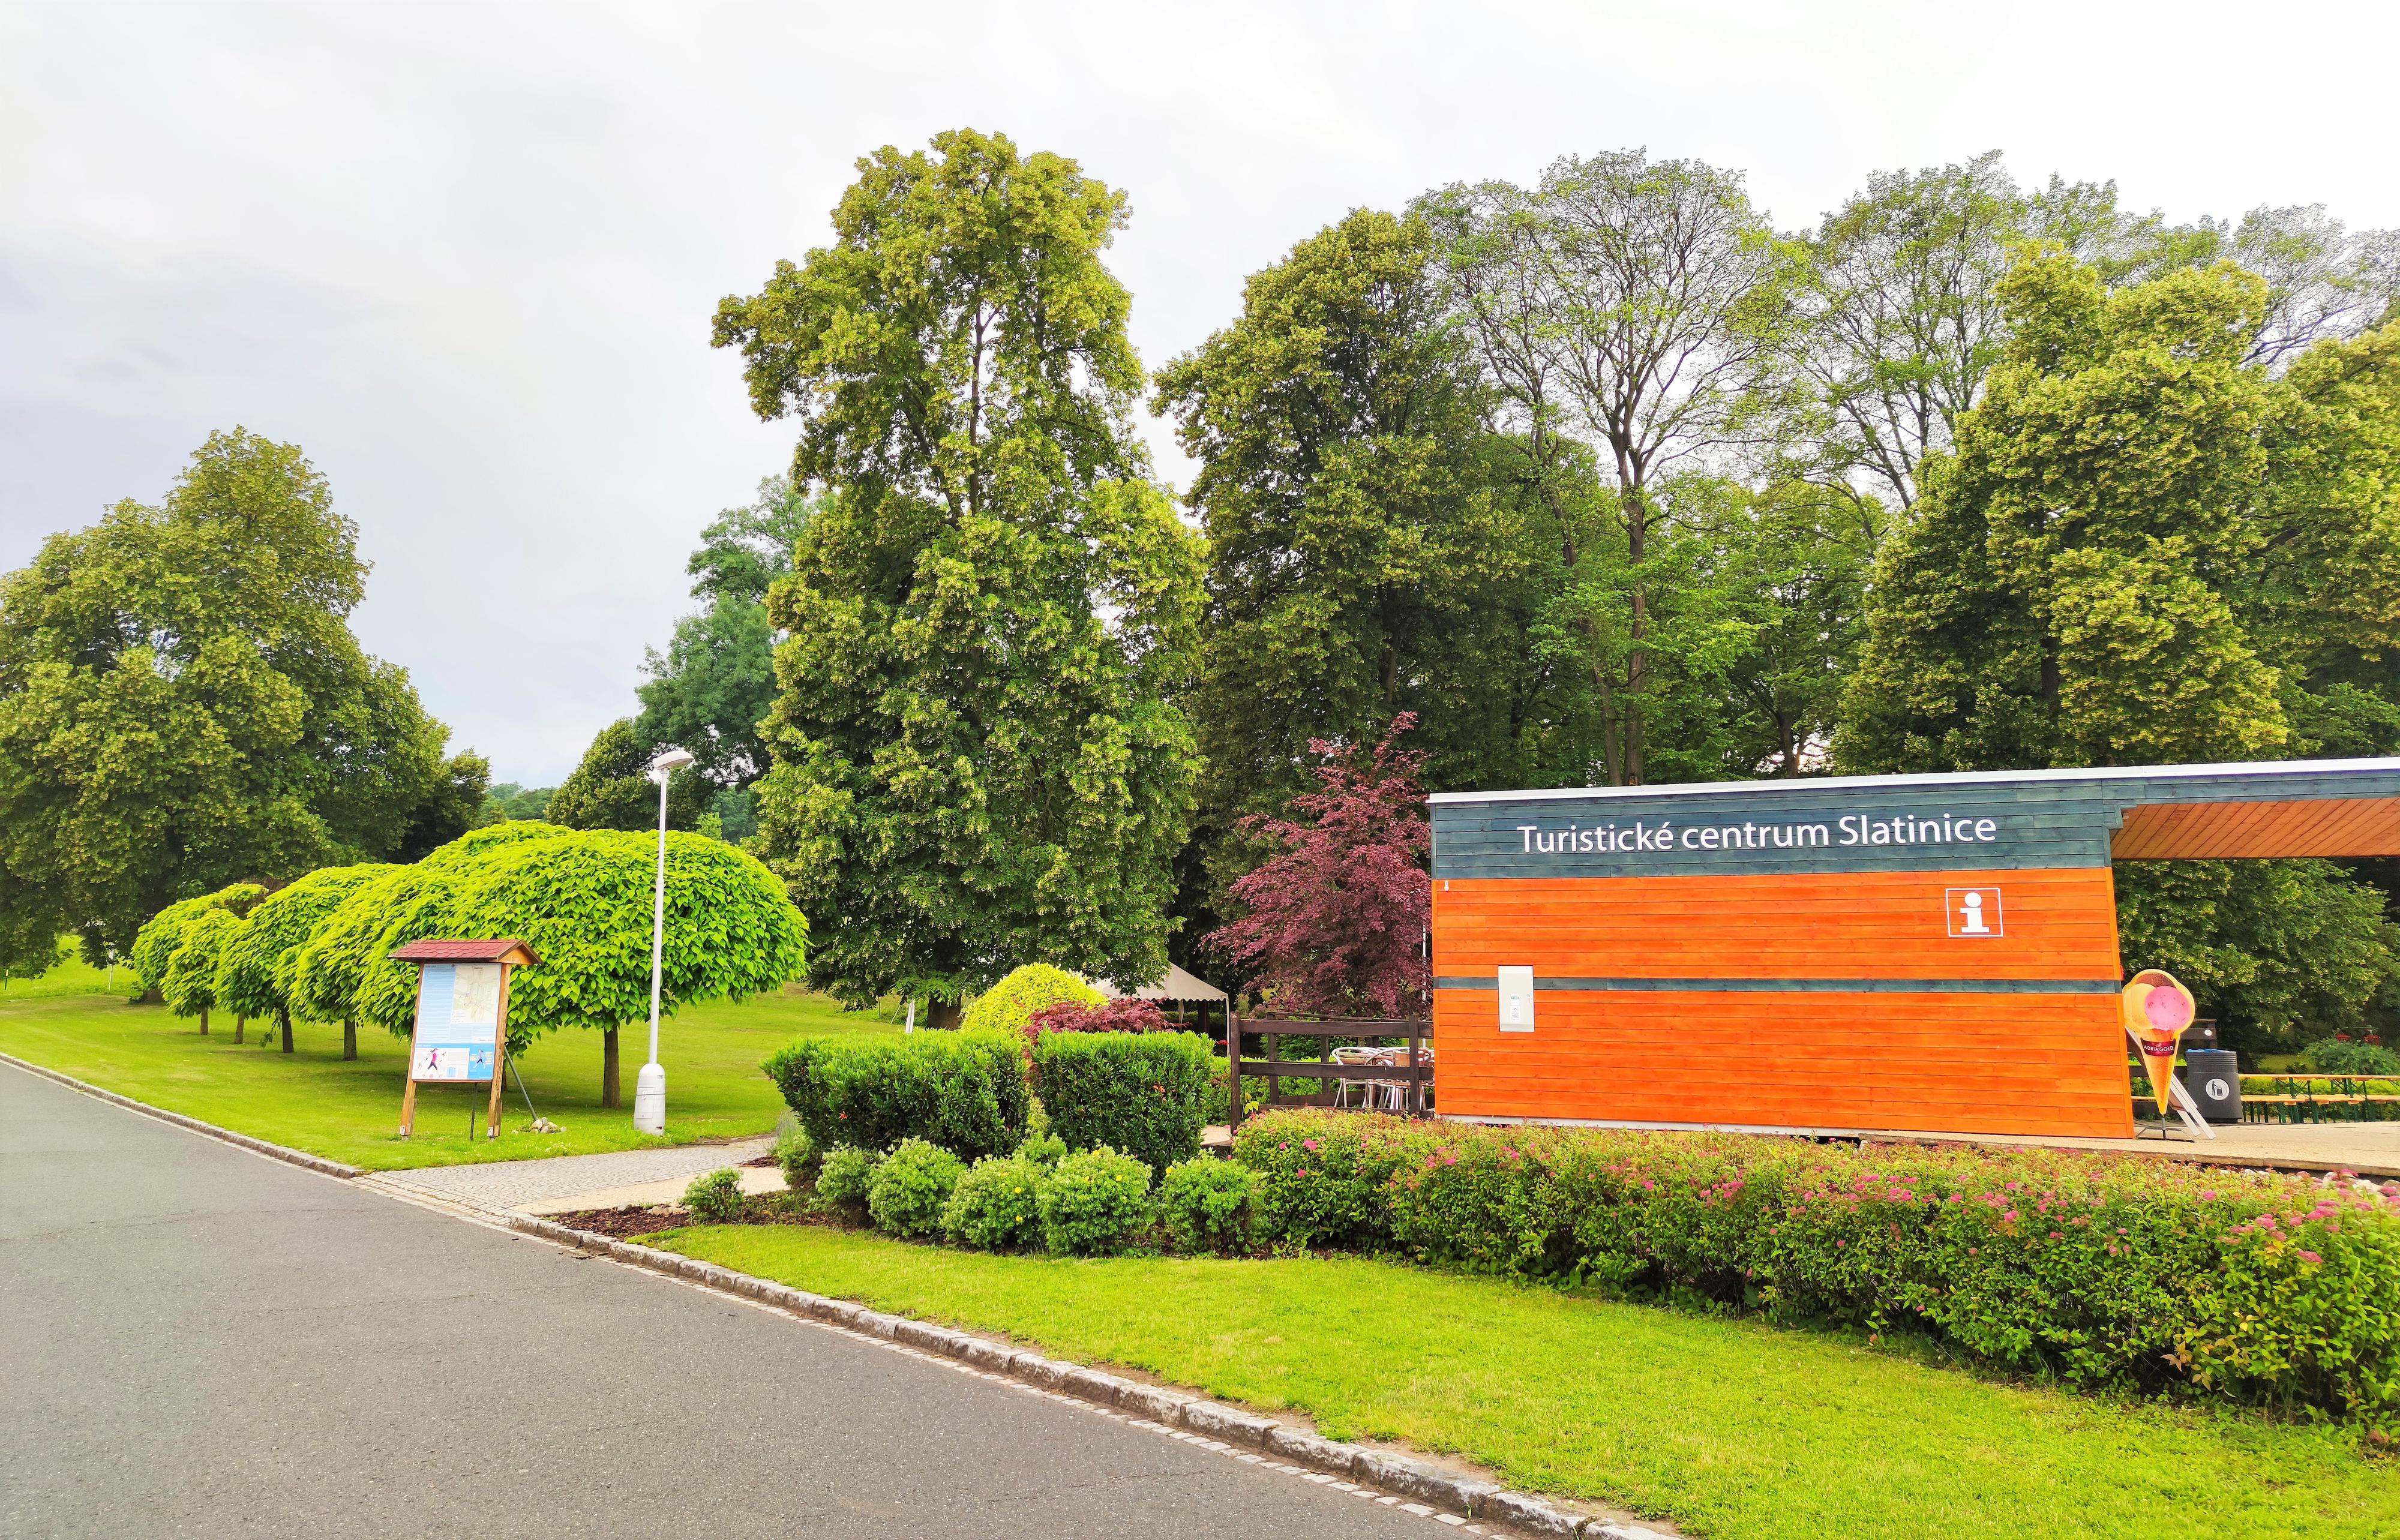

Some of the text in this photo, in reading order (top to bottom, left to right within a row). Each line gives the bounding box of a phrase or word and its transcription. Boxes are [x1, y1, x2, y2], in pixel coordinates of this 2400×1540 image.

[1516, 812, 1997, 853] Turistické centrum Slatinice
